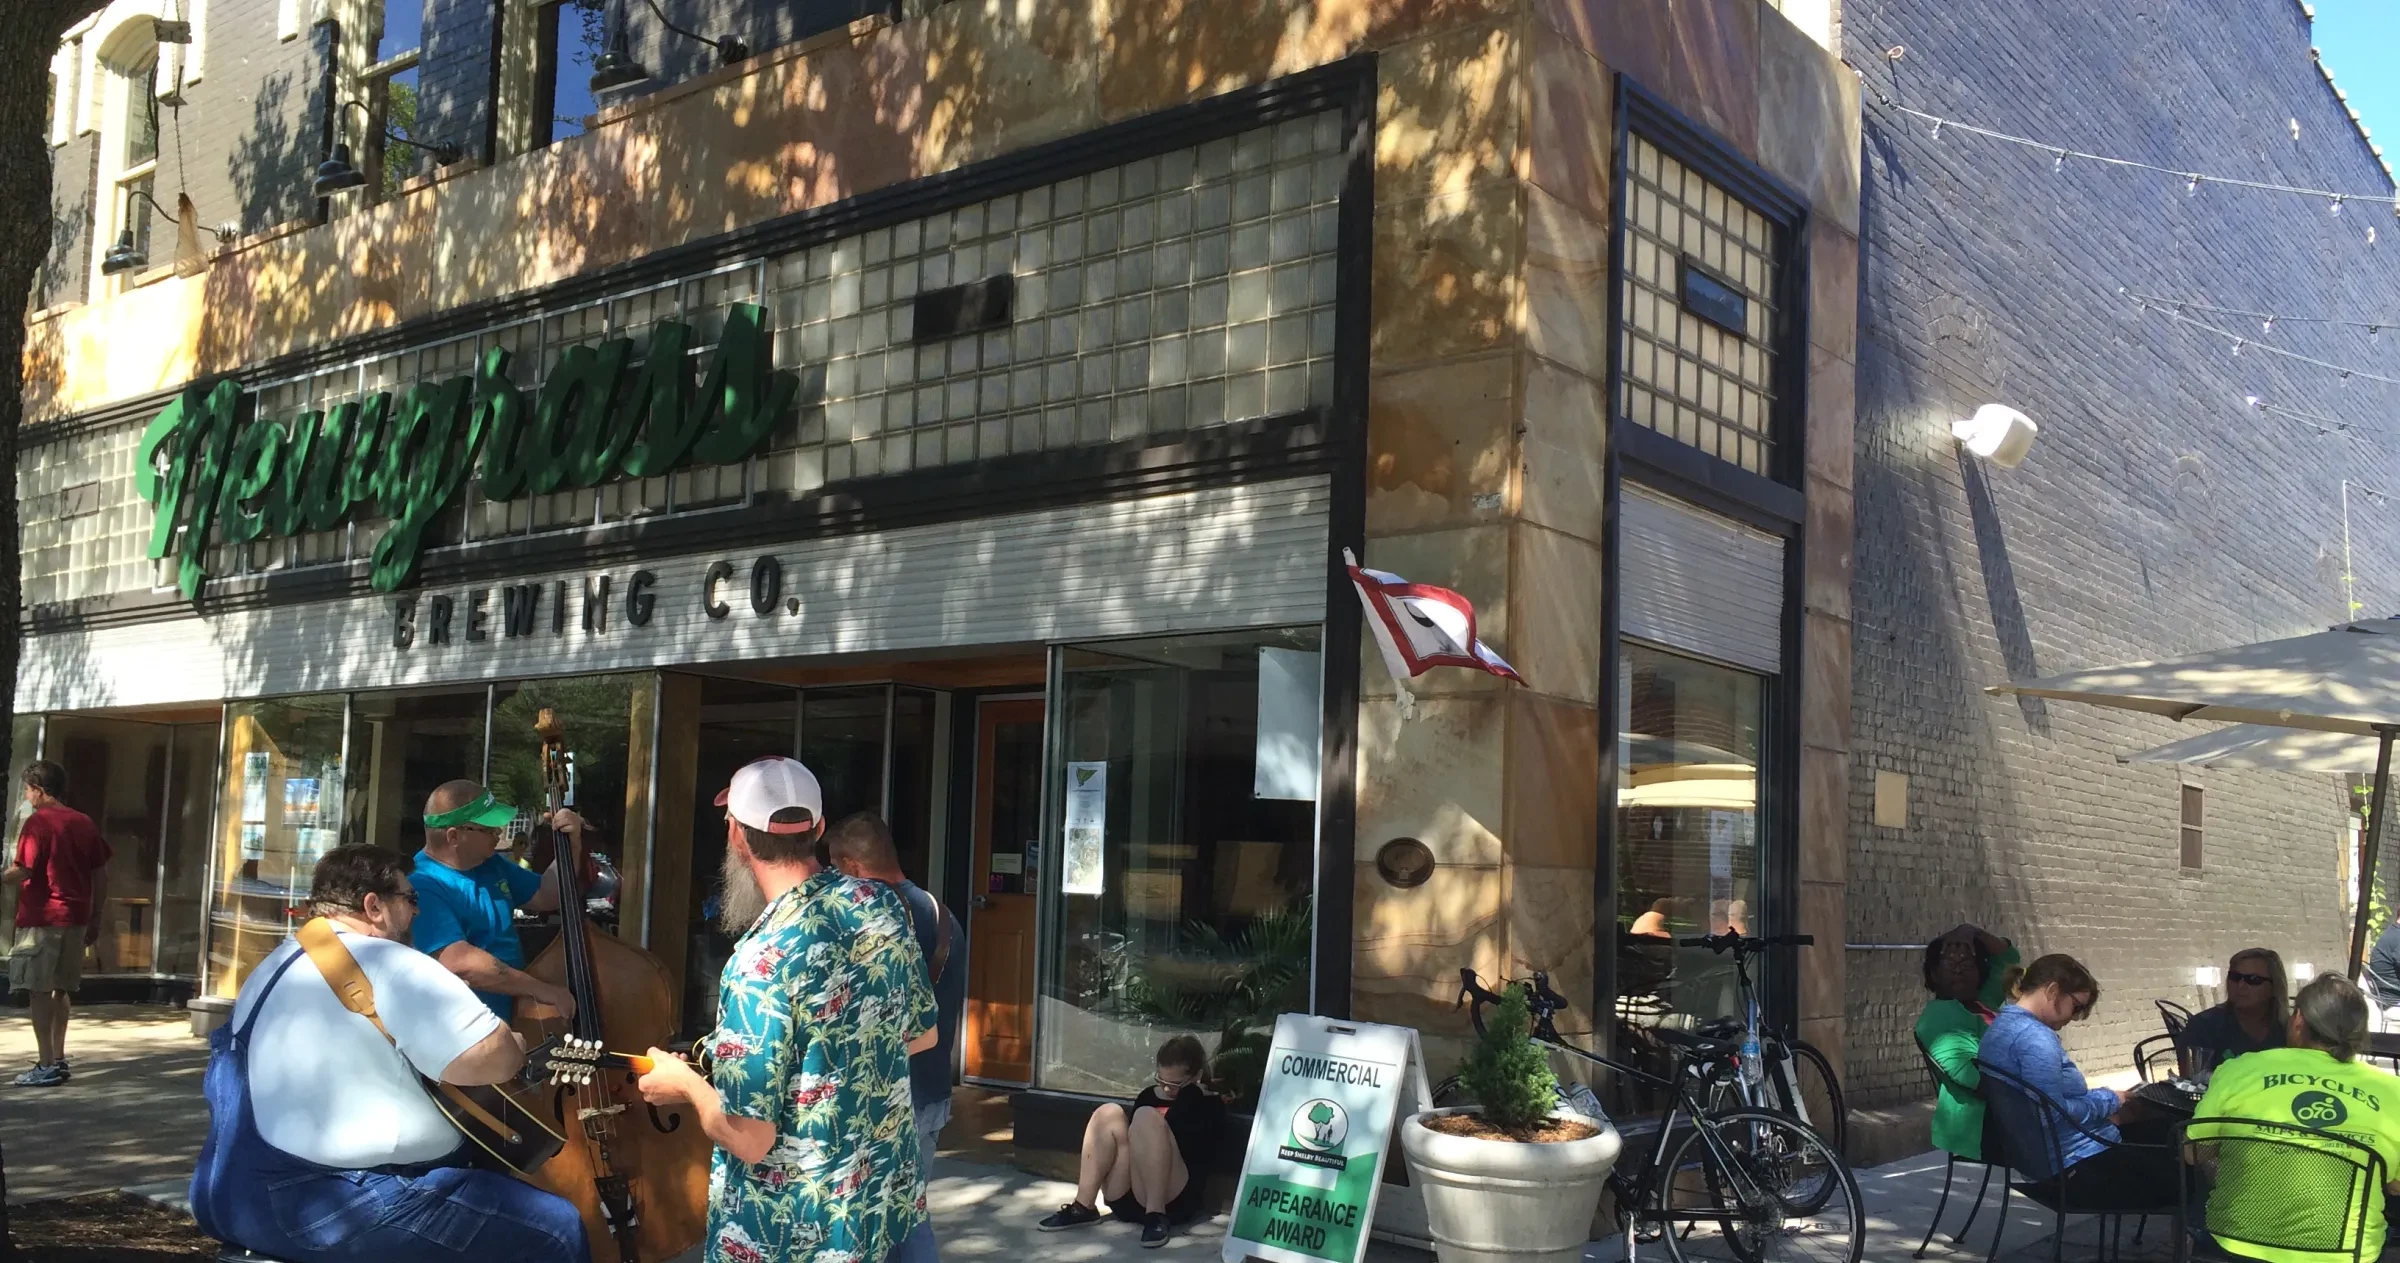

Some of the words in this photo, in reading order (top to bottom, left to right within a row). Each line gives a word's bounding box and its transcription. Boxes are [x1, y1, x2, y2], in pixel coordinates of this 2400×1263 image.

[135, 301, 800, 608] Newgrass
[393, 569, 656, 648] BREWING
[704, 554, 801, 620] CO.
[1281, 1054, 1381, 1088] COMMERCIAL
[2263, 1073, 2380, 1112] BICYCLES
[1280, 1148, 1294, 1156] KEEP
[1294, 1150, 1314, 1161] SHELBY
[1314, 1154, 1345, 1166] BEAUTIFUL
[1247, 1185, 1358, 1228] APPEARANCE
[1263, 1217, 1326, 1251] AWARD
